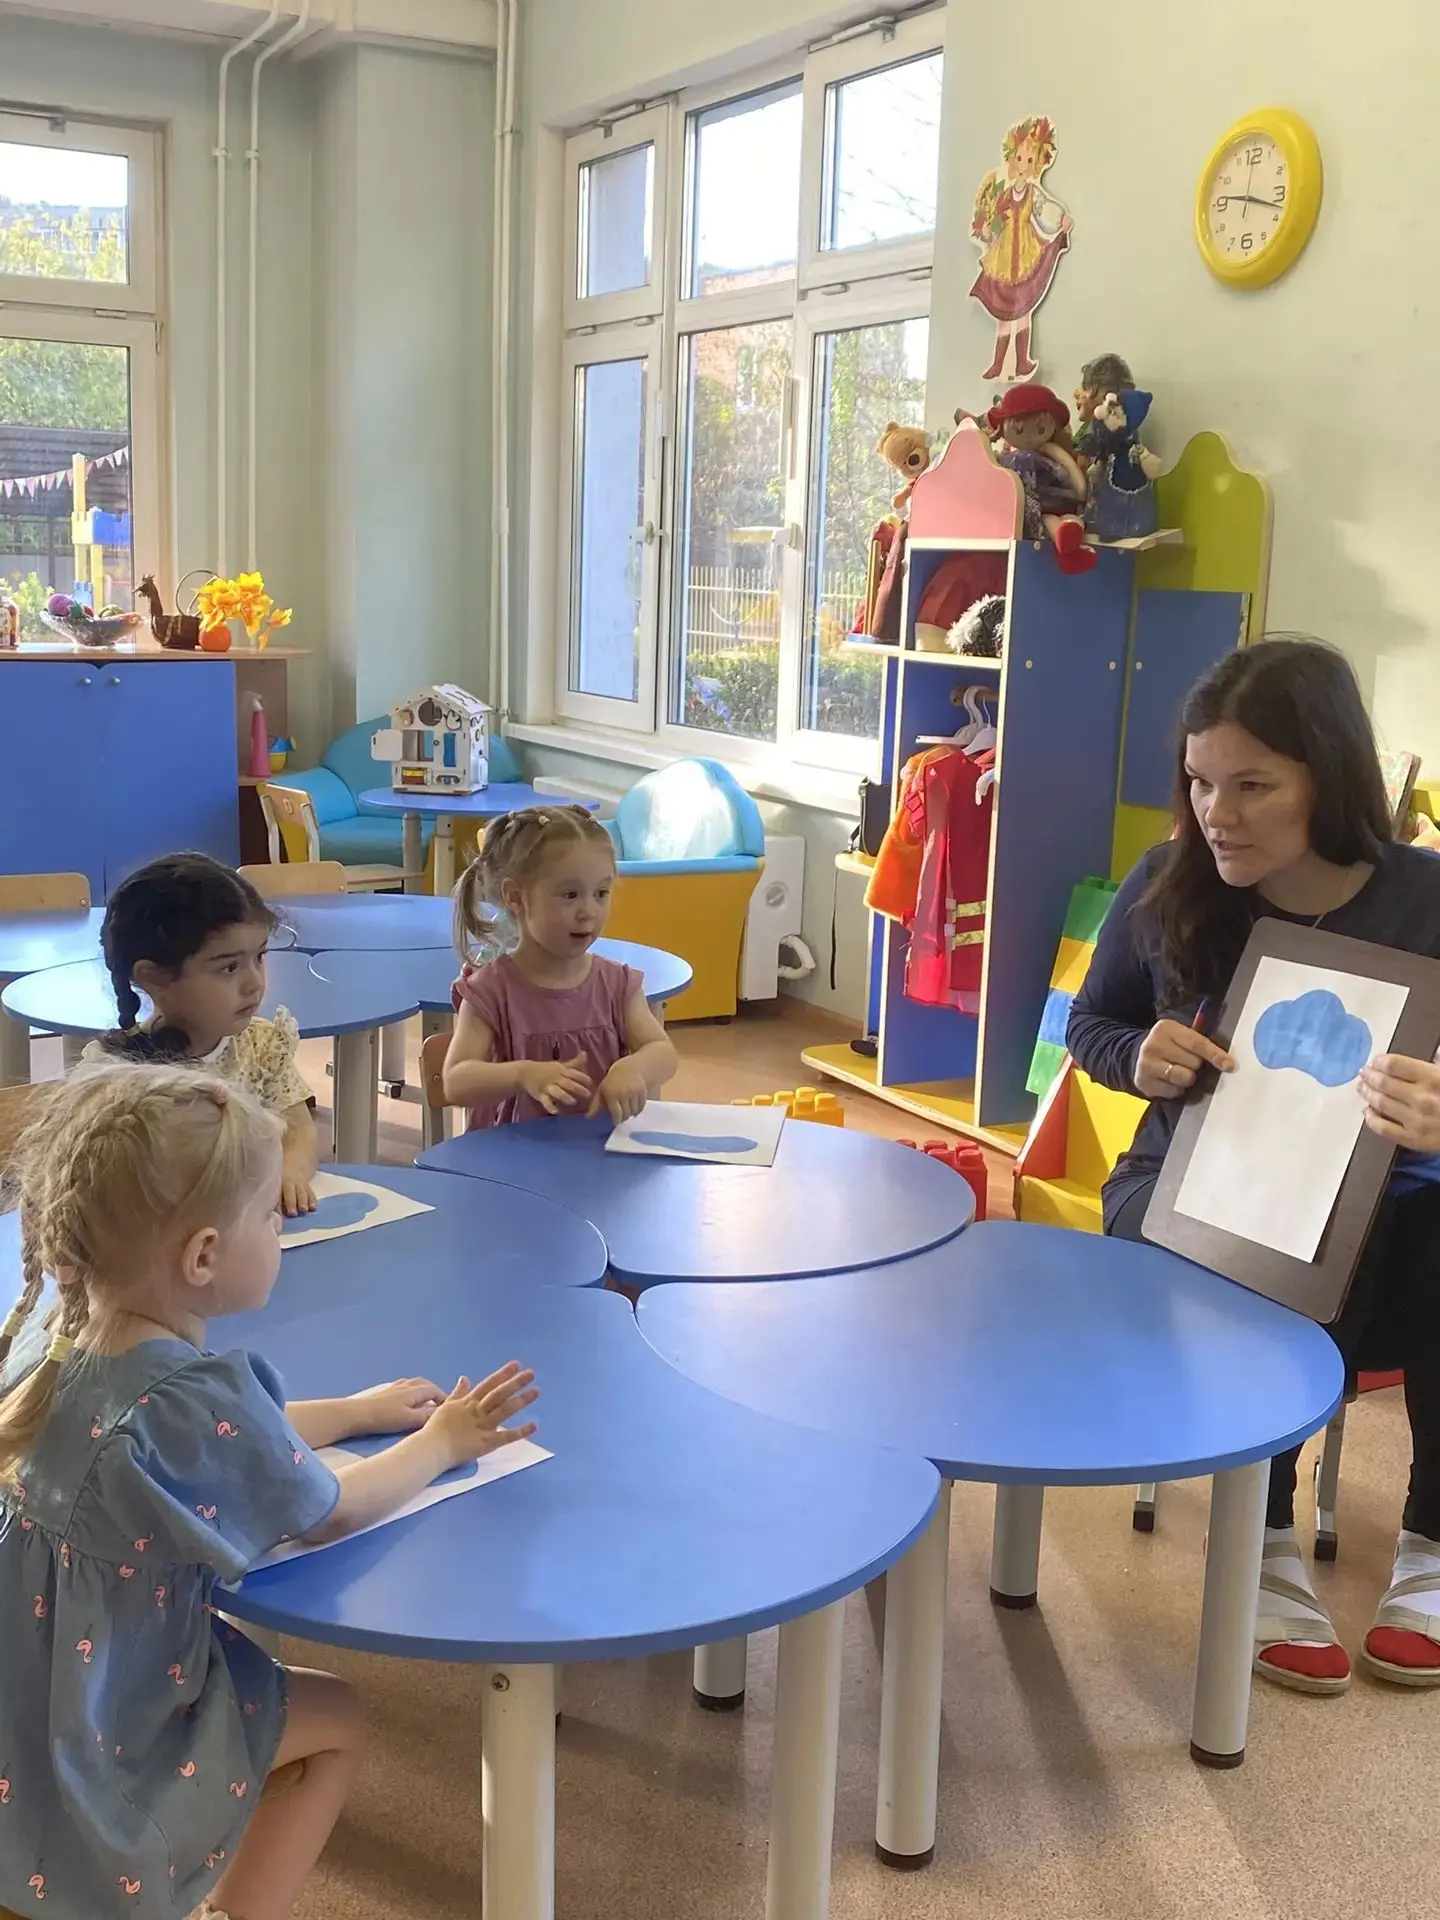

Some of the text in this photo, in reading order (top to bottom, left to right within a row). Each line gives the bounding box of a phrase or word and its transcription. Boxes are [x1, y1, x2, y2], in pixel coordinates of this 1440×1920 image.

[1246, 147, 1263, 166] 12
[1276, 166, 1283, 175] 2
[1223, 176, 1232, 185] 10
[1273, 185, 1286, 203] 3
[1216, 196, 1229, 212] 9
[1272, 213, 1279, 223] 4
[1241, 232, 1253, 249] 6
[1260, 231, 1267, 240] 5
[1229, 237, 1236, 246] 7
